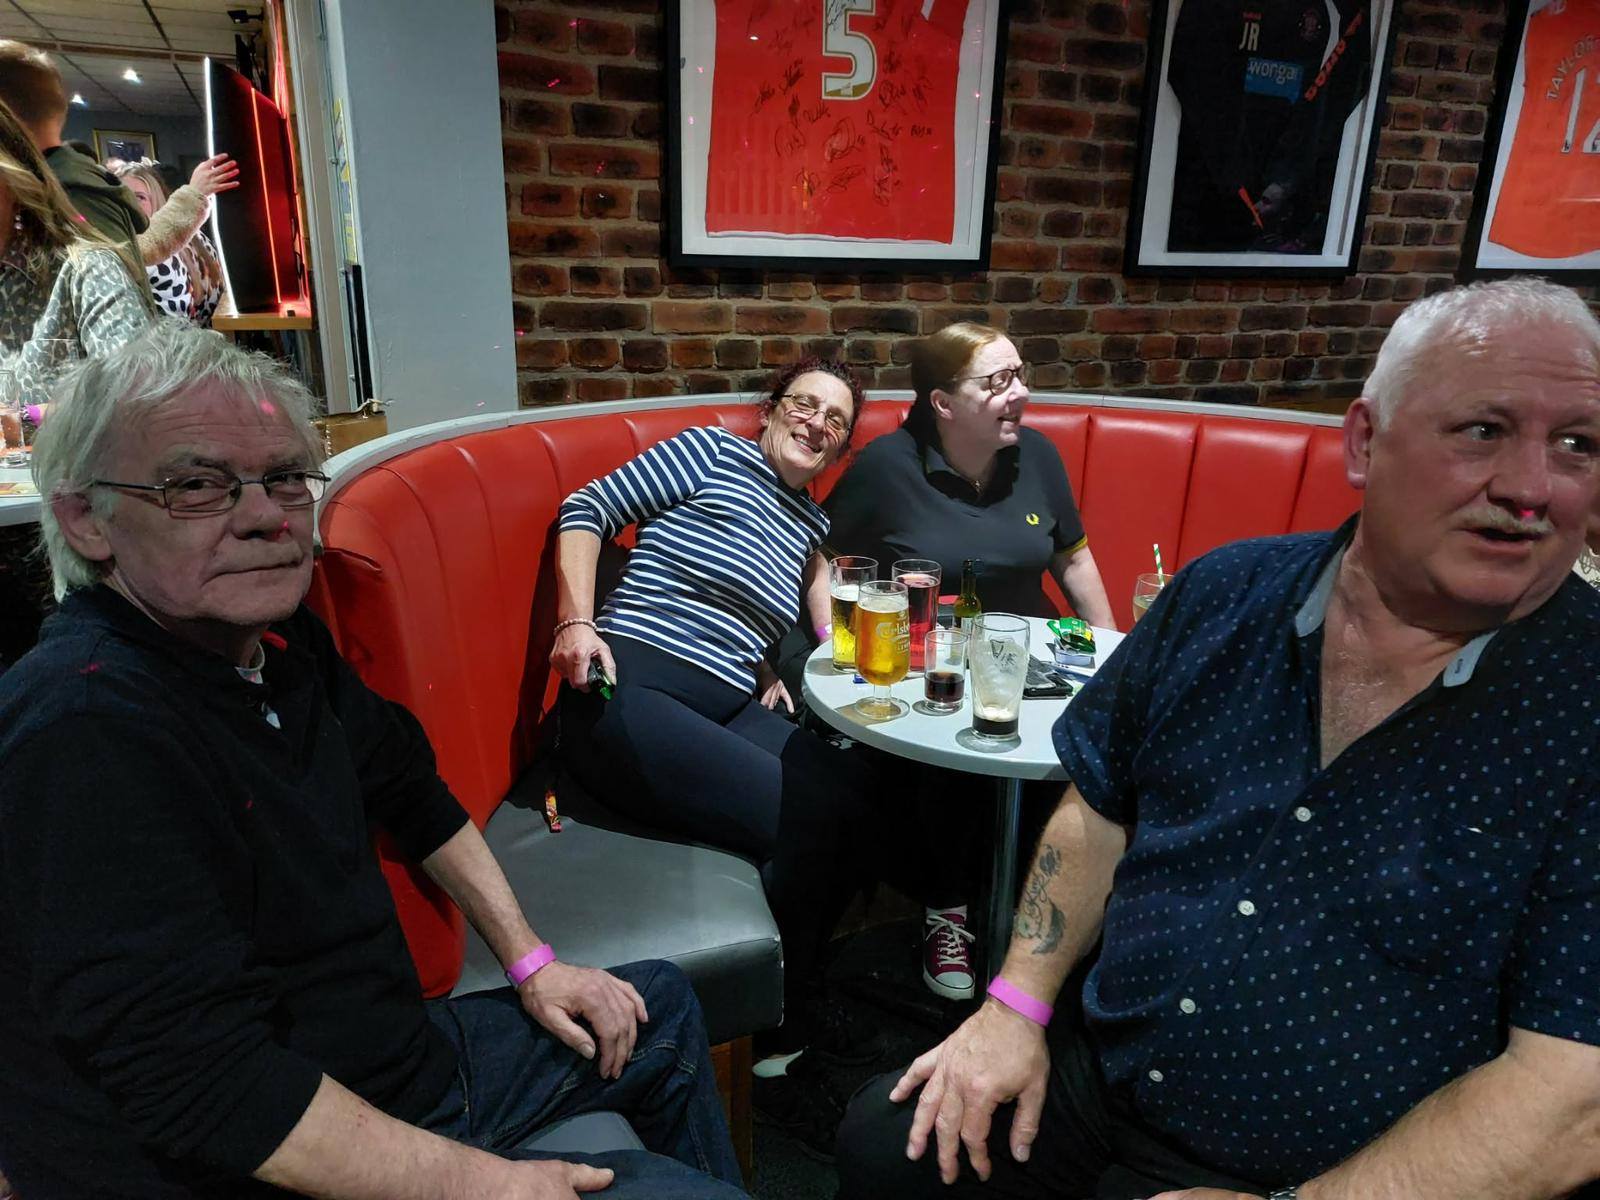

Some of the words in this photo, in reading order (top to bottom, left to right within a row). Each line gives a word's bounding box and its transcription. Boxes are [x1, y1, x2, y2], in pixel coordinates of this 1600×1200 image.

[821, 0, 878, 101] 5
[1238, 22, 1260, 52] JR
[1248, 60, 1298, 86] wonga
